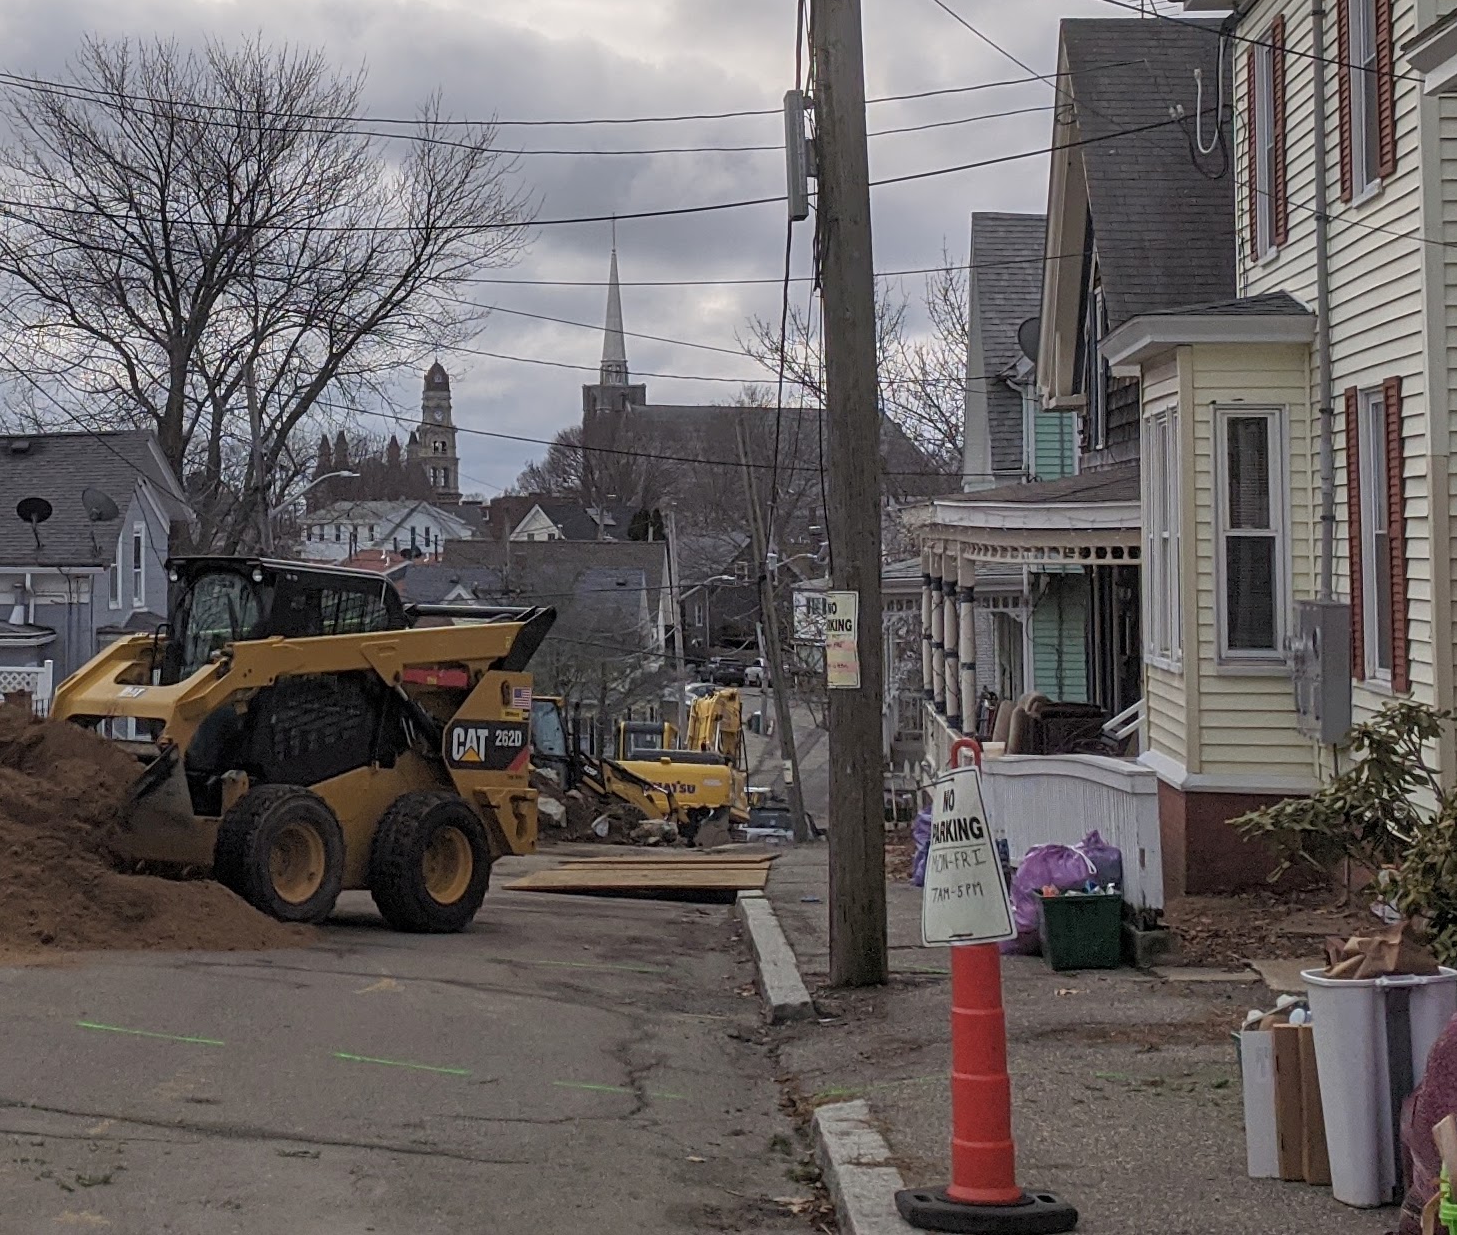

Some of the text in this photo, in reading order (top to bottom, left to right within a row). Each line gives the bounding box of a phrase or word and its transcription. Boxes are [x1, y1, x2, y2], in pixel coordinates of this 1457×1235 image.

[828, 602, 837, 615] NO
[452, 727, 522, 762] CAT 262D
[943, 789, 955, 813] NO
[933, 816, 984, 844] PARKING
[932, 882, 983, 903] 7AM-5PM
